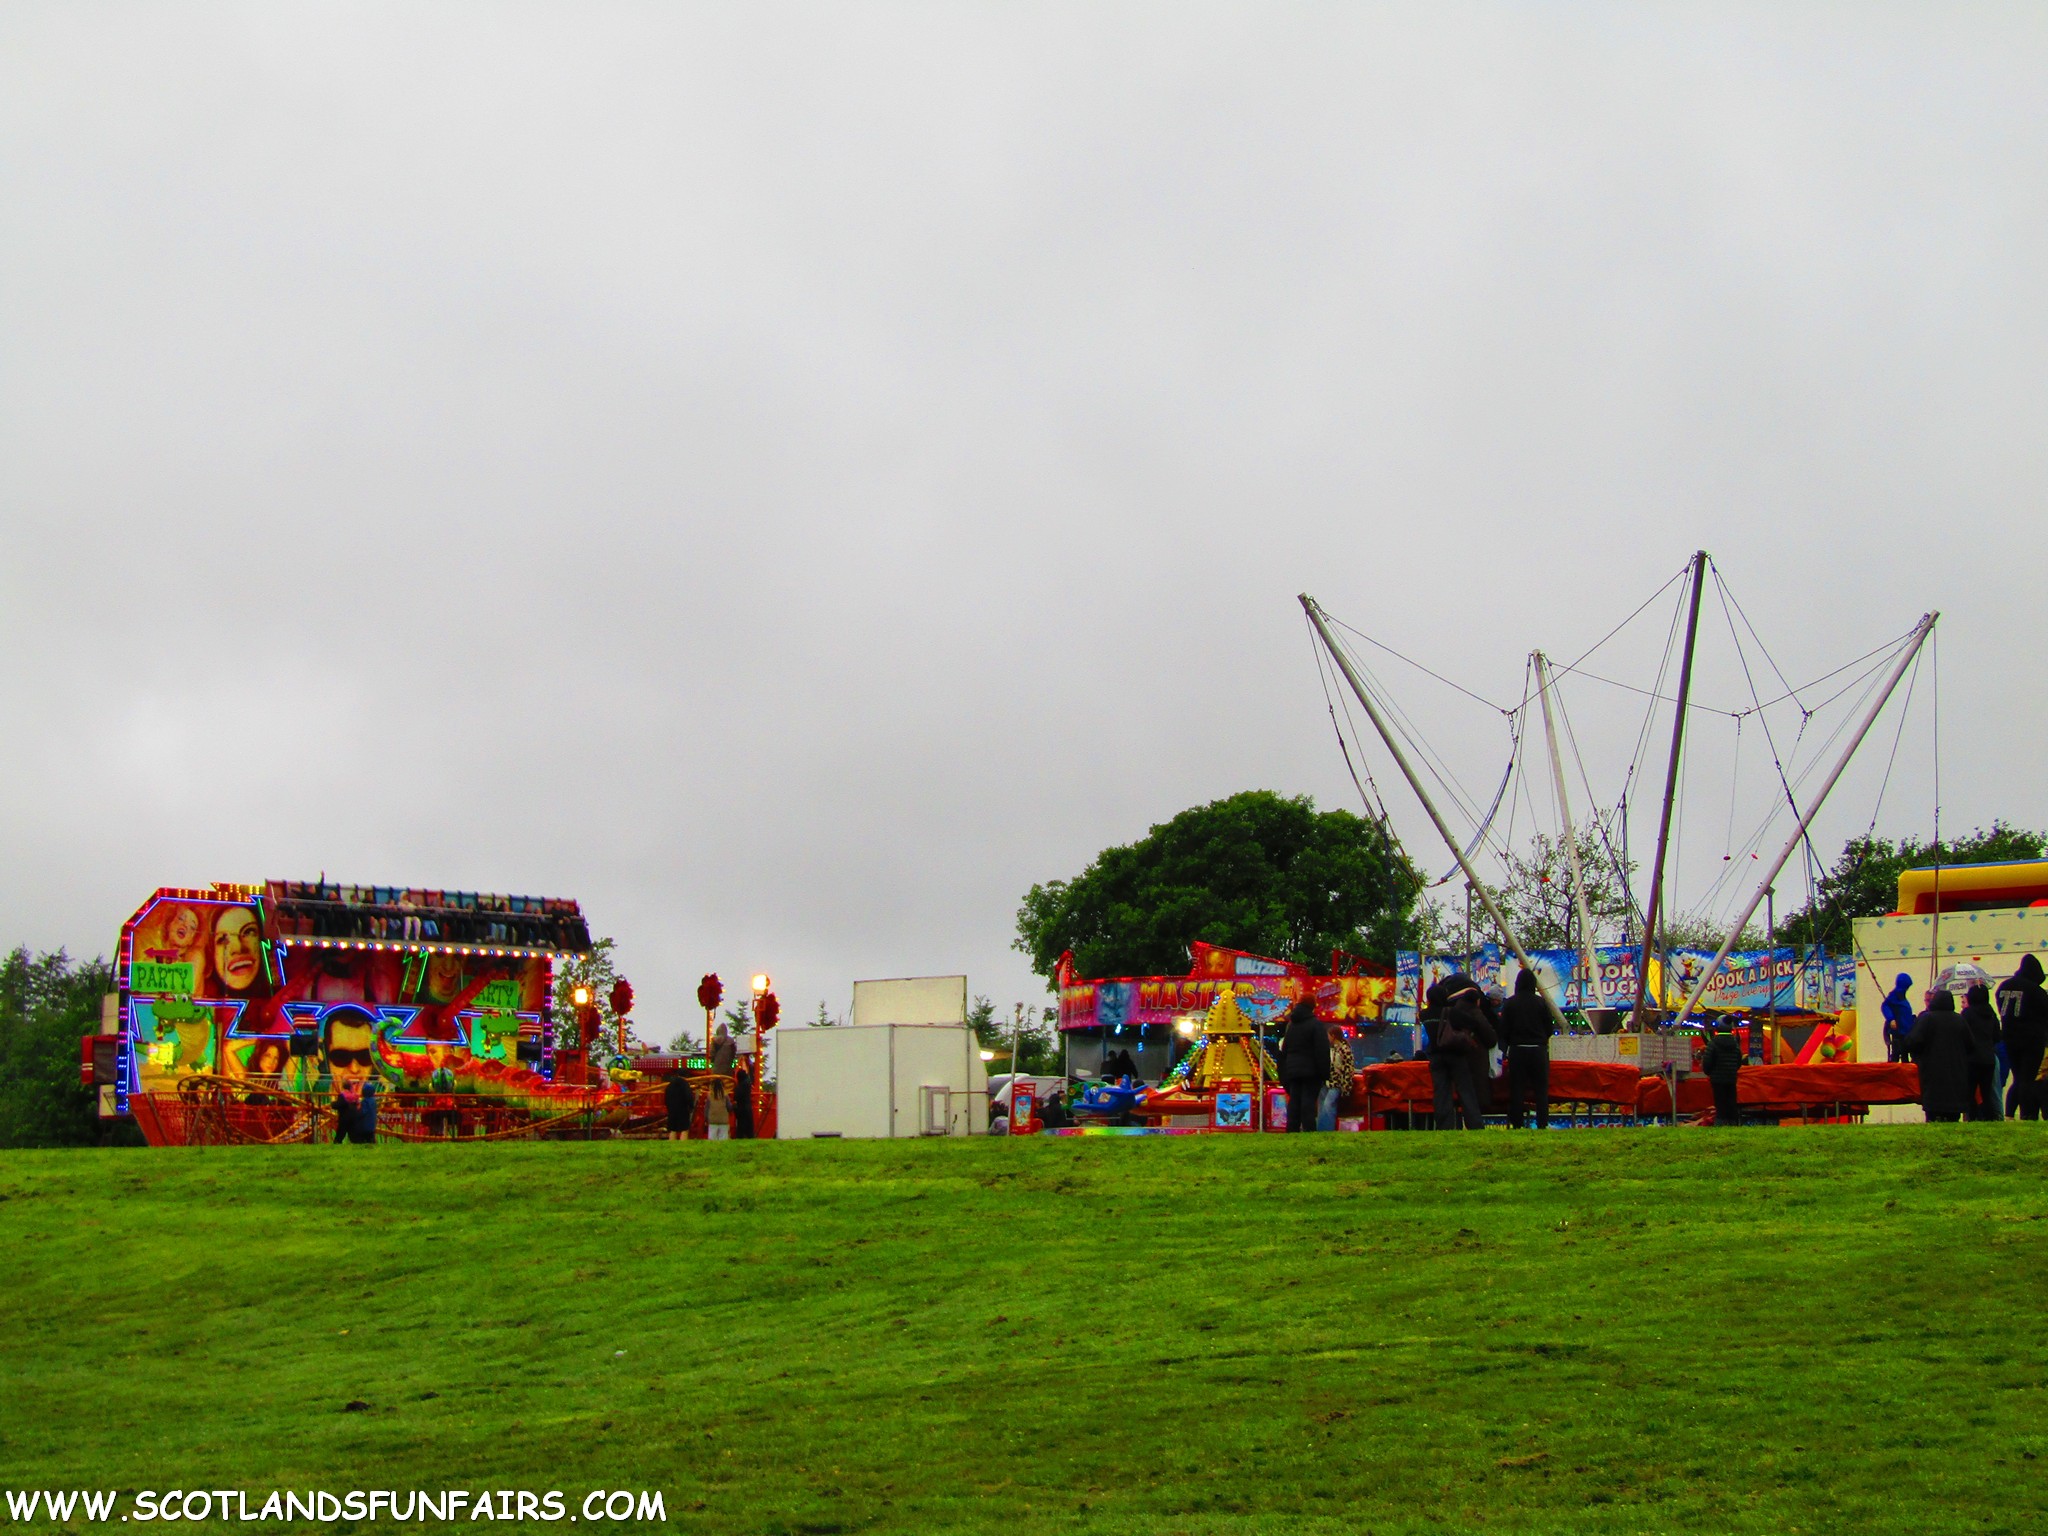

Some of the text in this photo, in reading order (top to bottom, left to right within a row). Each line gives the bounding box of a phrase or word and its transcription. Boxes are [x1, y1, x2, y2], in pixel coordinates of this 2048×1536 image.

[137, 966, 189, 990] PARTY
[1706, 960, 1794, 992] HOOK A DUCK
[474, 983, 514, 1005] ARTY
[1565, 981, 1579, 996] A
[1999, 990, 2023, 1017] 77
